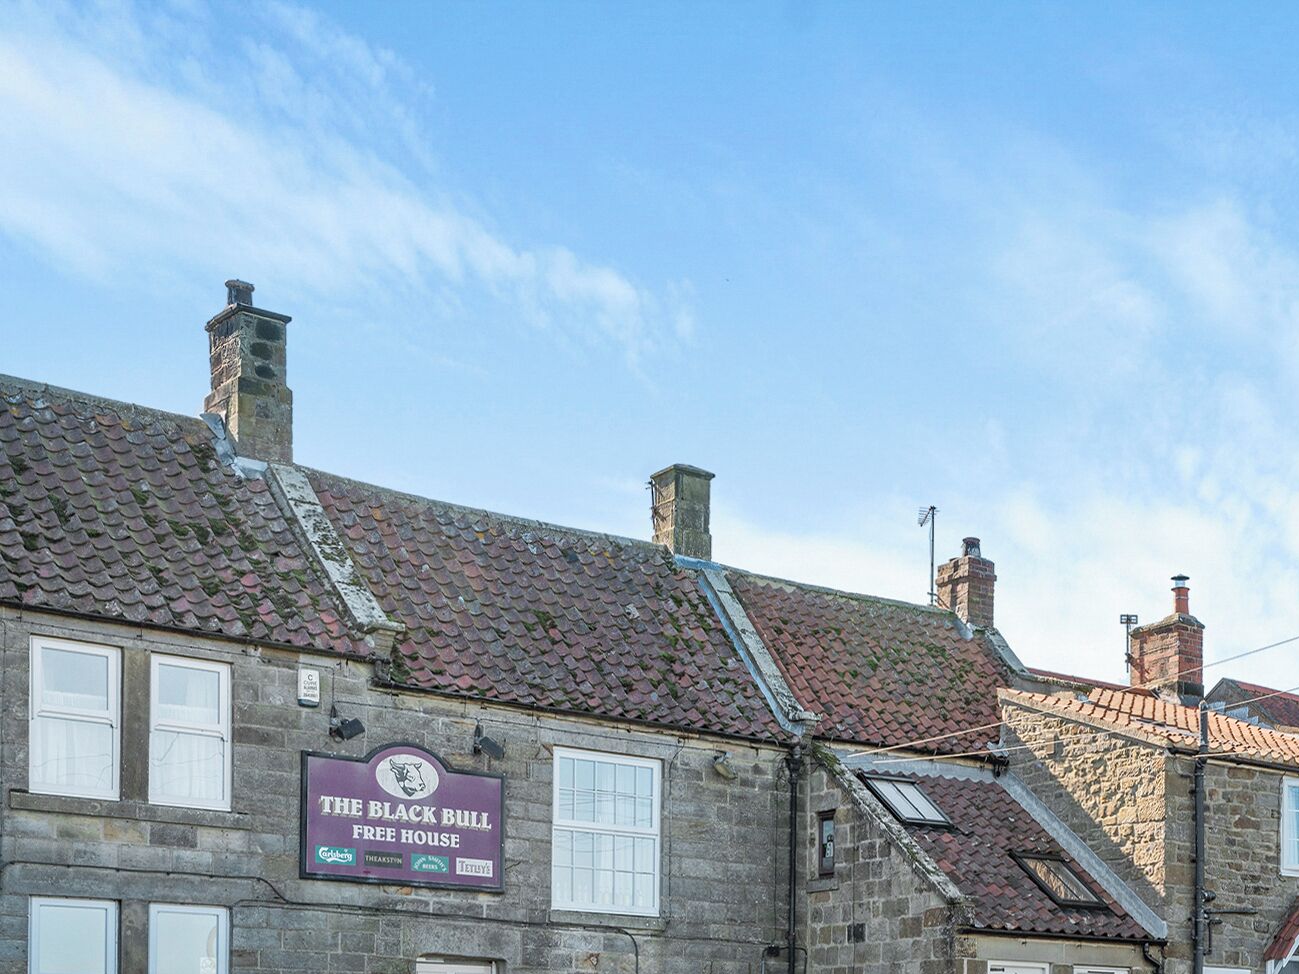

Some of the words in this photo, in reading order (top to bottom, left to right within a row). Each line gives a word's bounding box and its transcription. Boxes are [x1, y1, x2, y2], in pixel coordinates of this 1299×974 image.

[320, 795, 363, 817] THE
[368, 800, 438, 824] BLACK
[442, 807, 492, 830] BULL
[352, 824, 396, 842] FREE
[400, 829, 460, 848] HOUSE
[318, 846, 353, 862] Carlsberg
